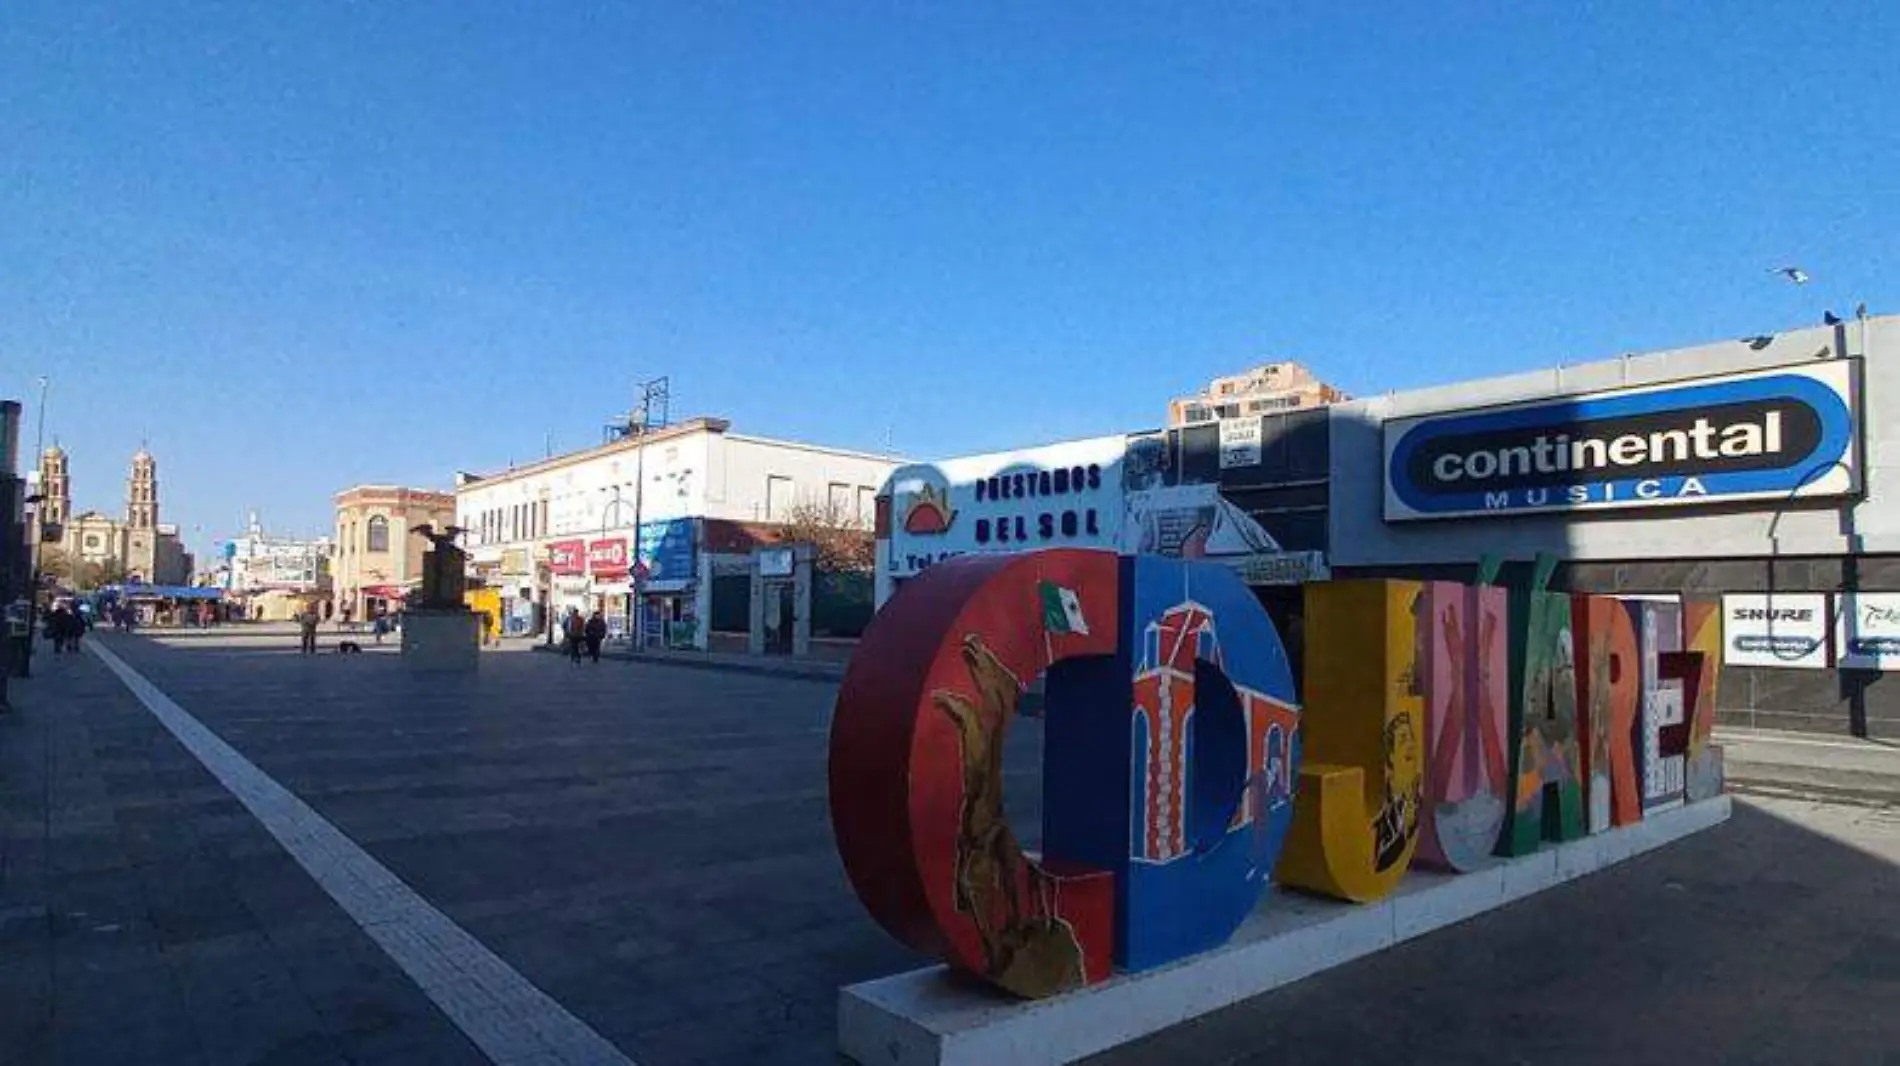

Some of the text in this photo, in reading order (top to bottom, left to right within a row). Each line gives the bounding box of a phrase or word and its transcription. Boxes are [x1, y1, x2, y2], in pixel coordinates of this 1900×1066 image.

[1432, 411, 1782, 482] continental
[975, 463, 1101, 503] PRESTAMOS
[1484, 477, 1708, 509] MUSICA
[975, 508, 1100, 543] DEL SOL
[1733, 609, 1813, 622] SHURE
